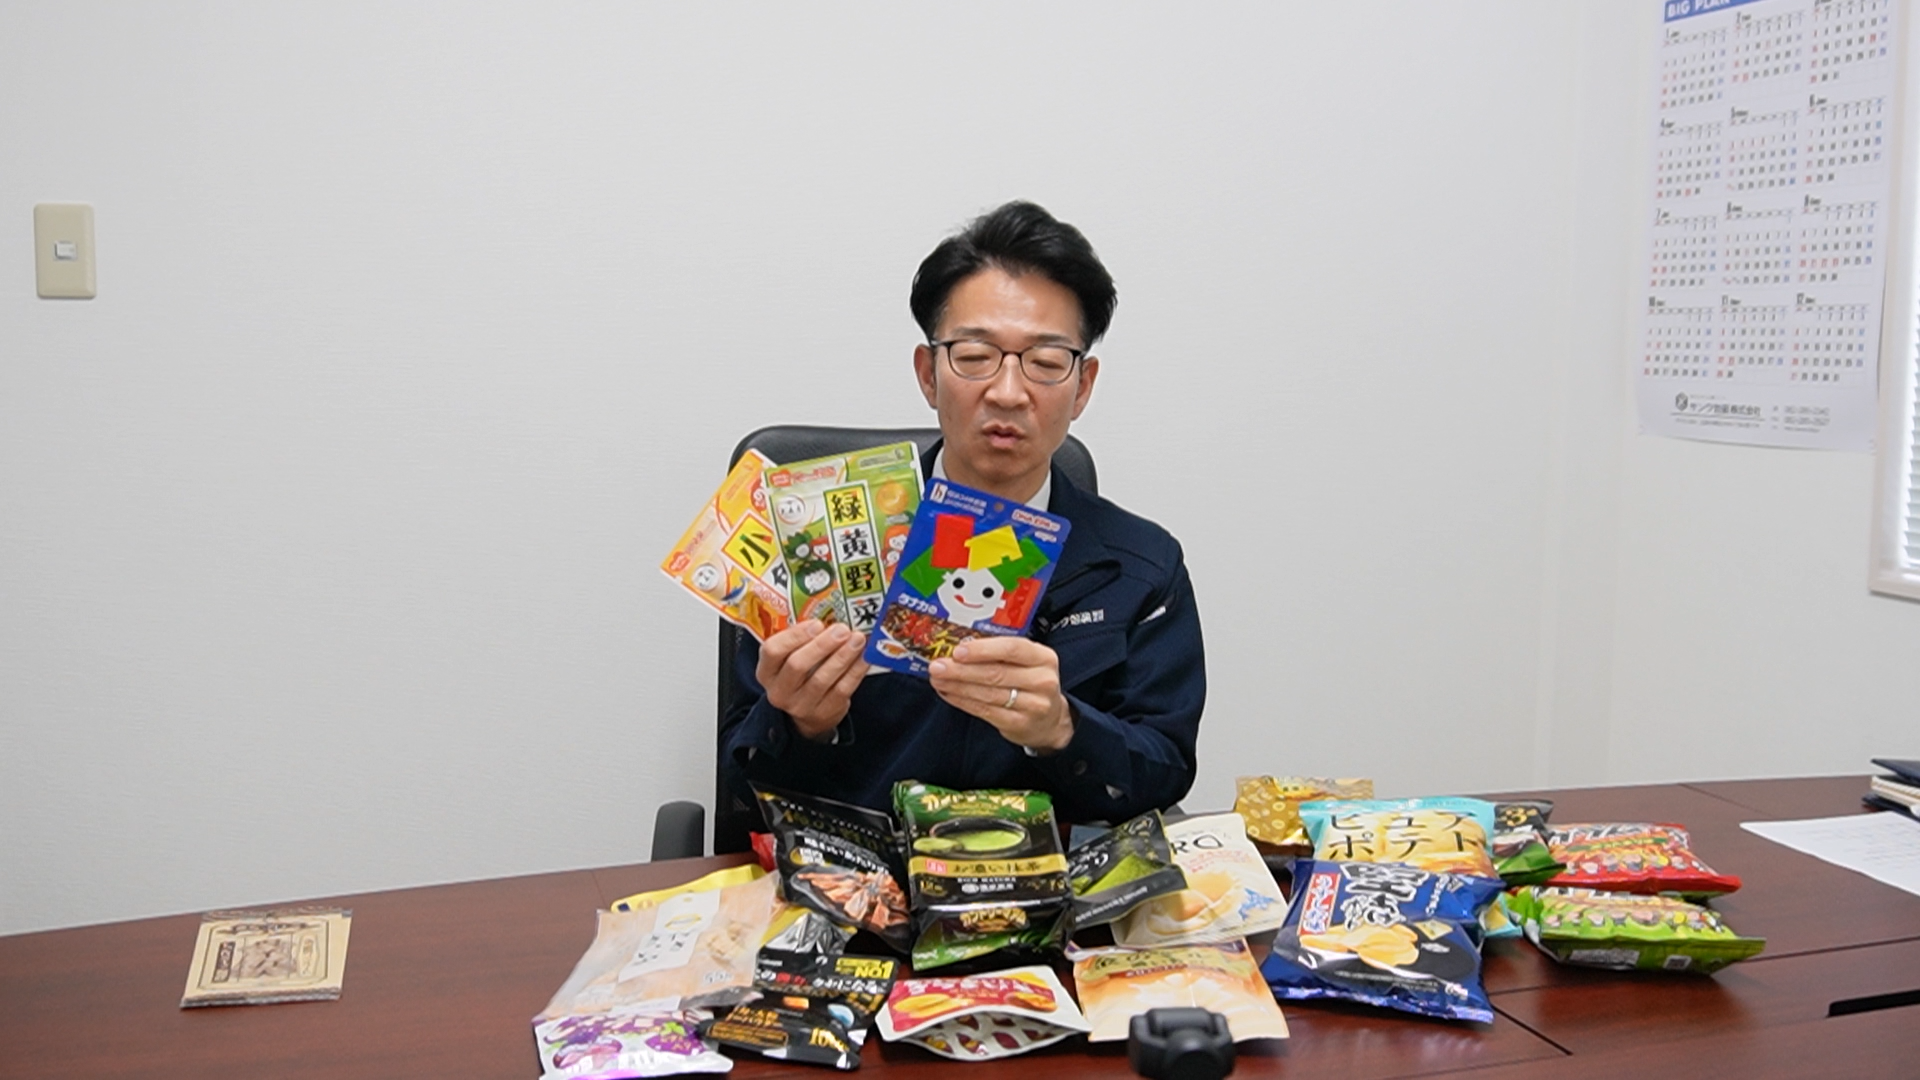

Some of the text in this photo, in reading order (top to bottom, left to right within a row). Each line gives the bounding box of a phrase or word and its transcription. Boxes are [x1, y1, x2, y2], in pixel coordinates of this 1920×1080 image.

[1668, 0, 1730, 17] BIG PLA
[830, 490, 882, 628] 緑黄野菜
[1331, 810, 1478, 832] ピュア
[1328, 831, 1482, 860] ポテト
